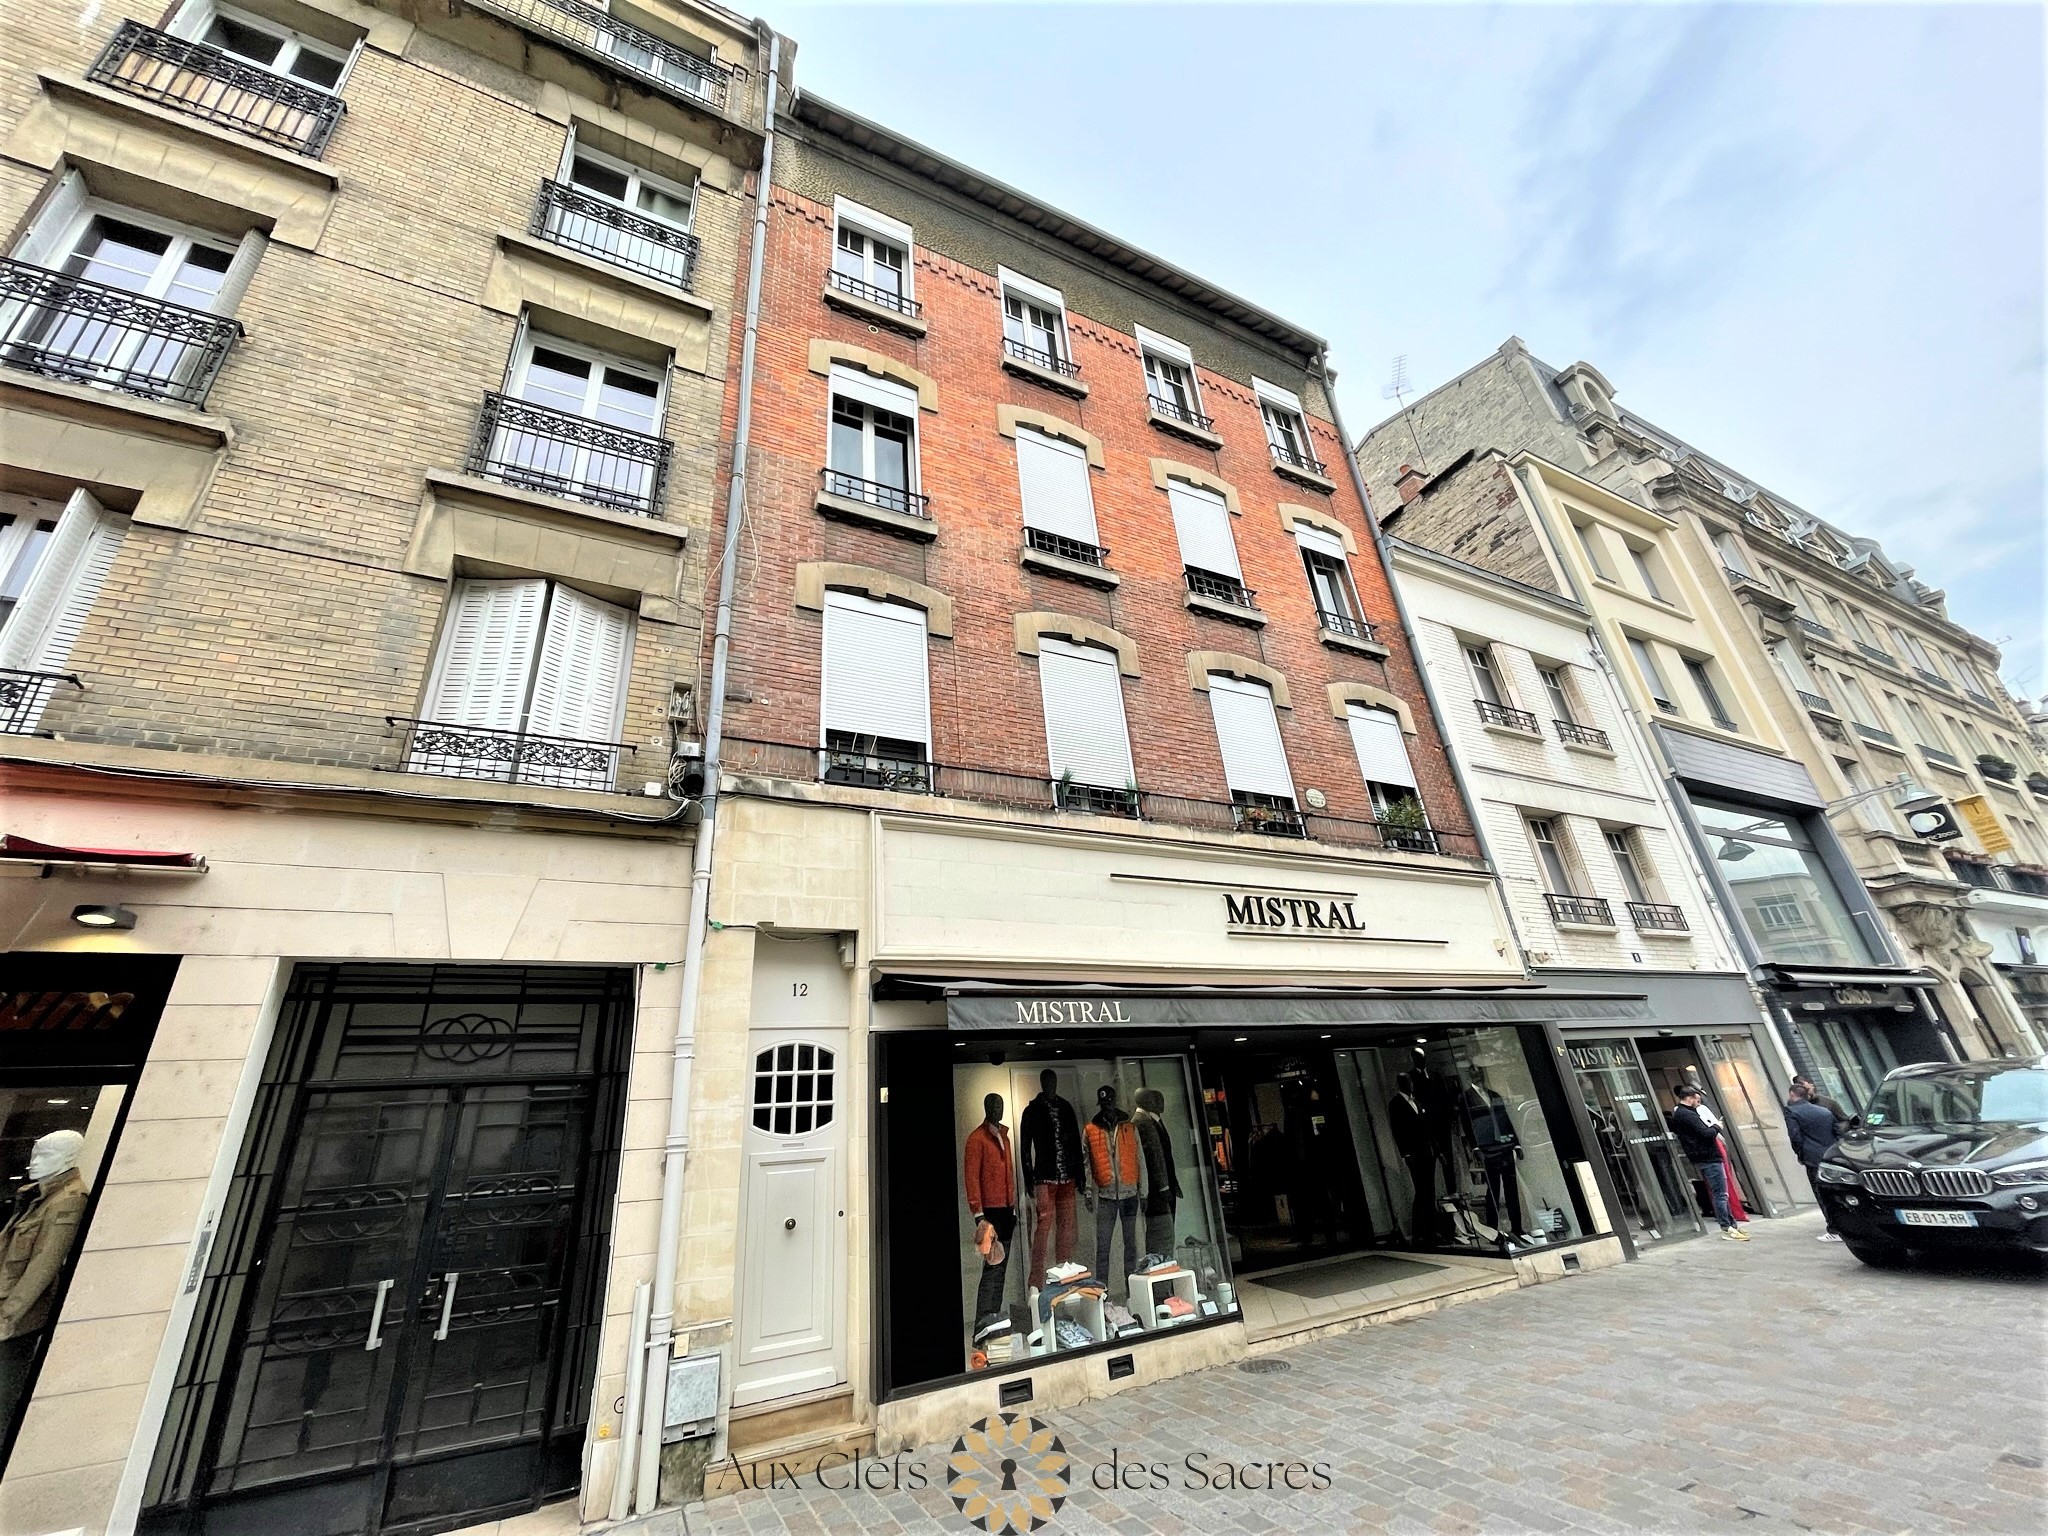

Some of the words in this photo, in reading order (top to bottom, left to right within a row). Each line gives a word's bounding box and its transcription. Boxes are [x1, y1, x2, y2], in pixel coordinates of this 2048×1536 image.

[1223, 893, 1366, 931] MISTRAL
[791, 982, 809, 997] 12
[1016, 1000, 1131, 1024] MISTRAL
[1568, 1046, 1634, 1067] MISTRAL
